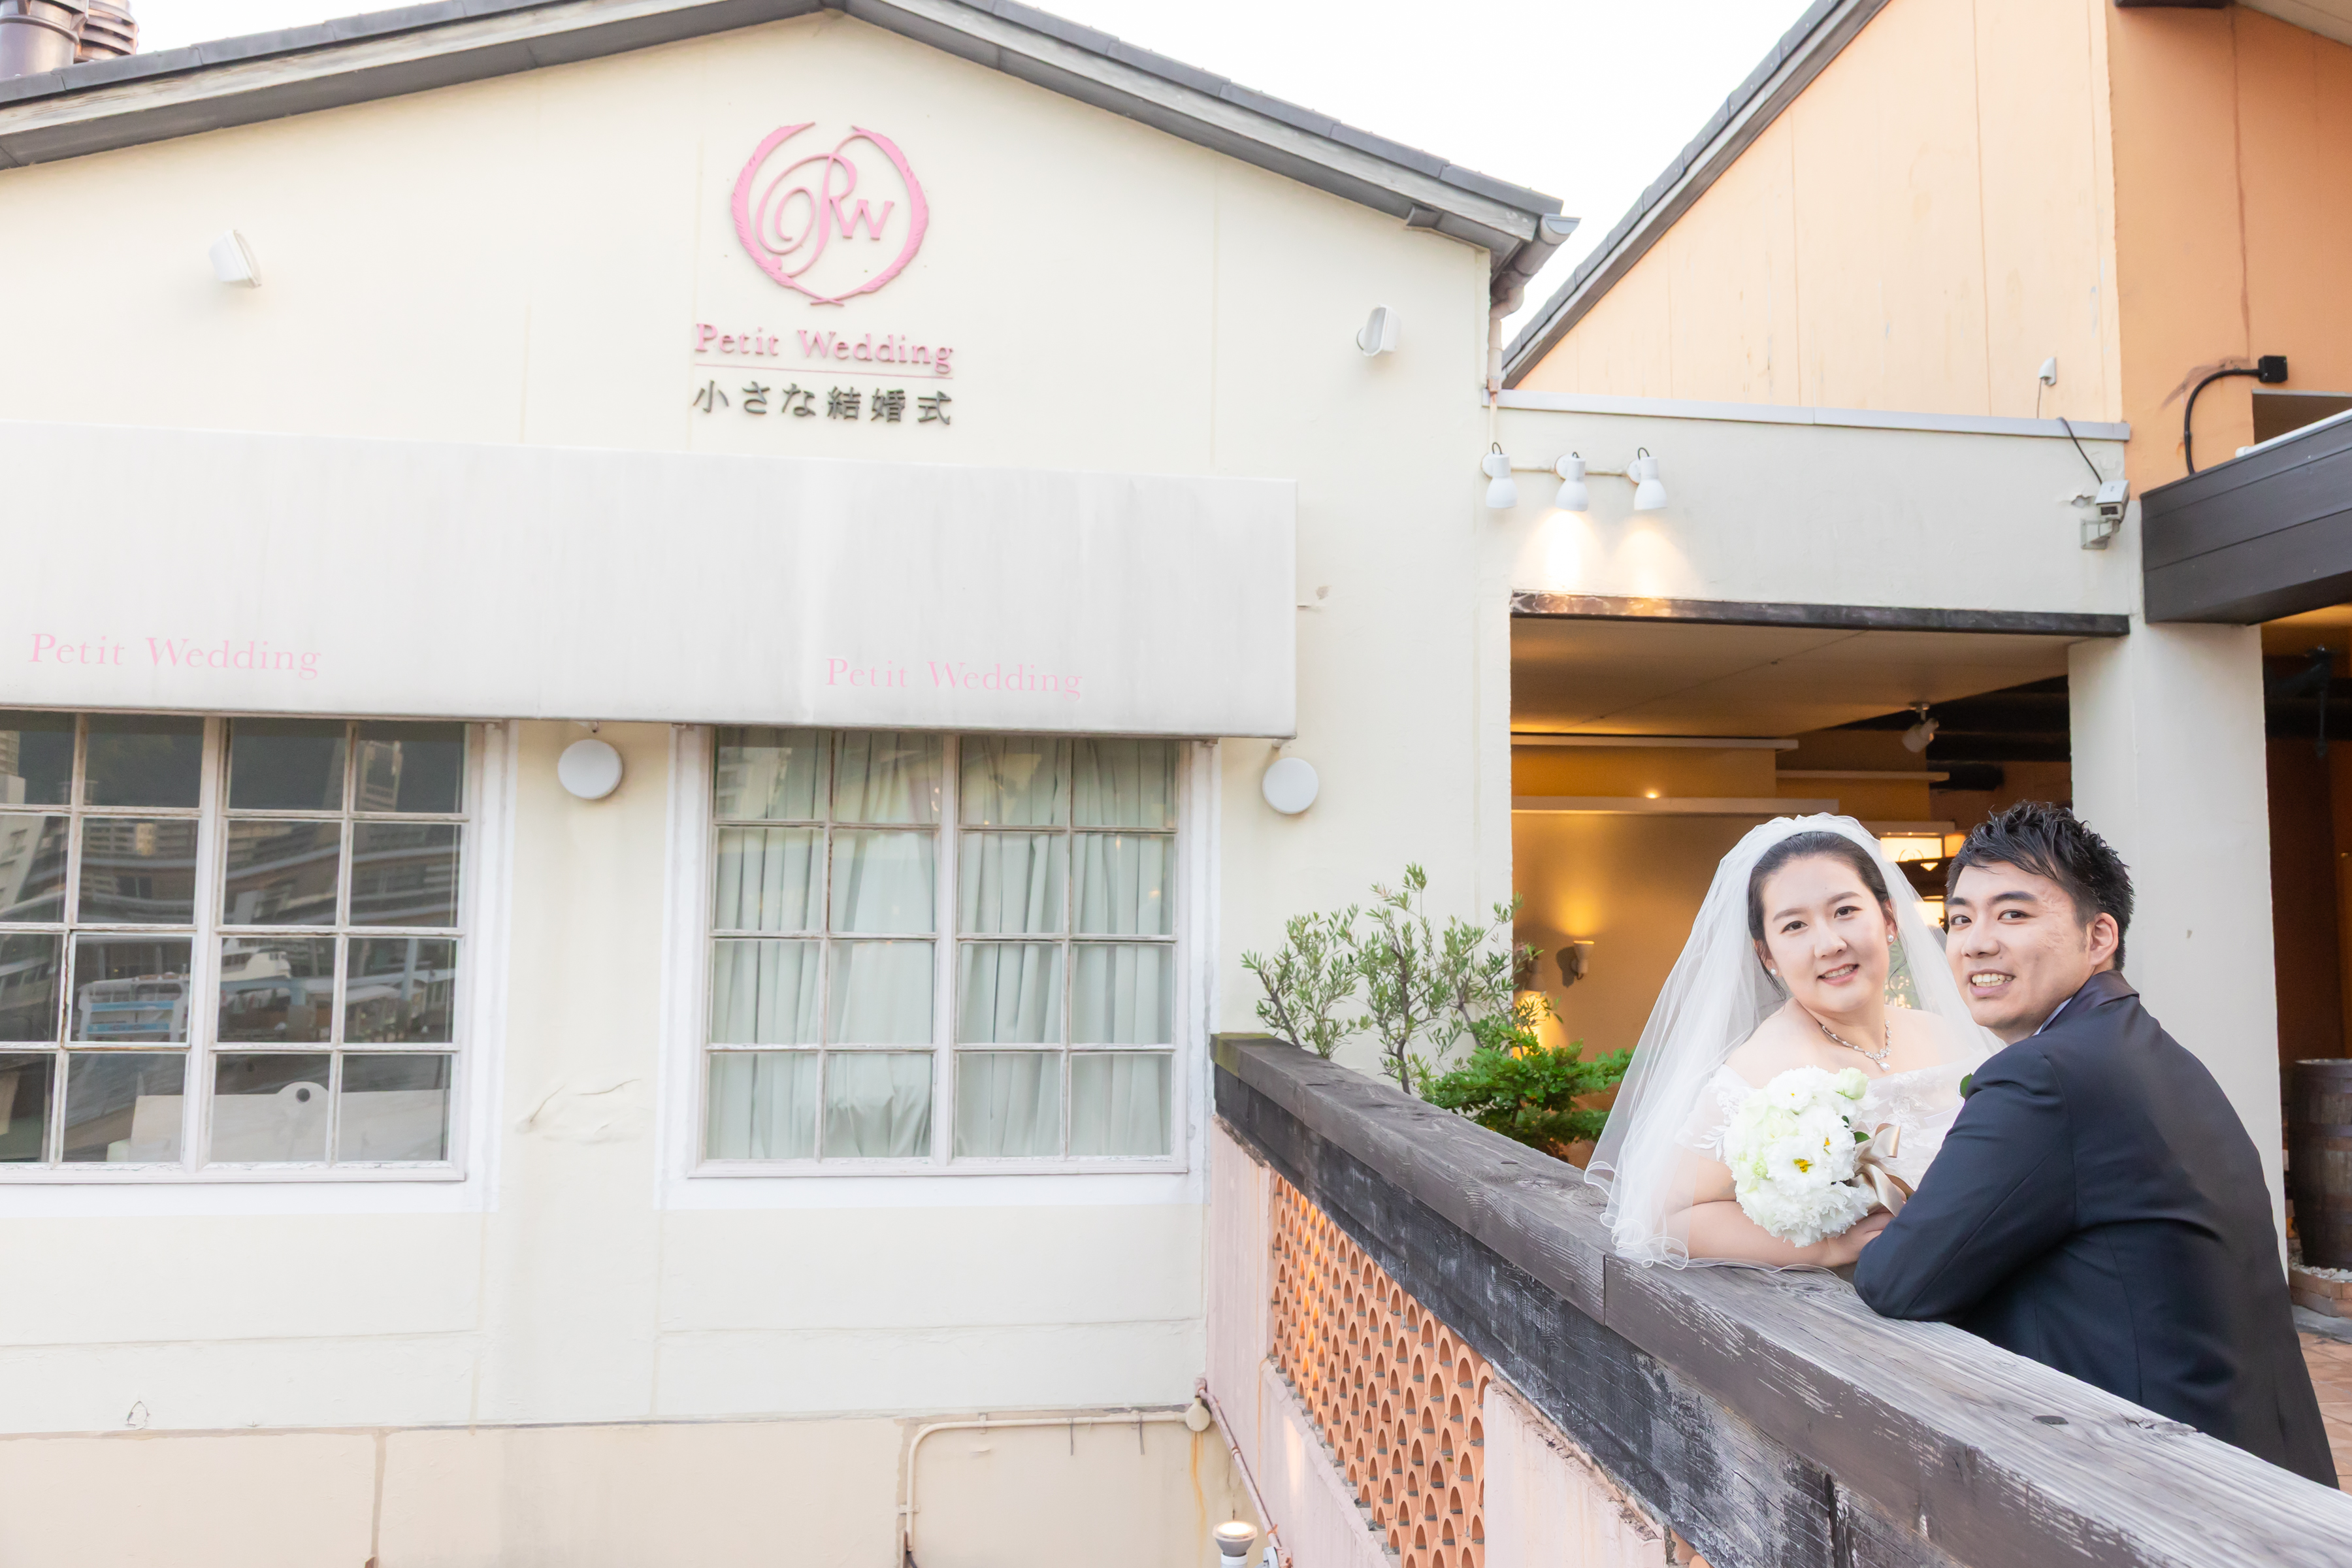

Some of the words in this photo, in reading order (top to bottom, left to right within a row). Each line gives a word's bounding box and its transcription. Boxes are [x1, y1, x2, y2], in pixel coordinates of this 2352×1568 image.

[694, 323, 779, 356] Petit
[797, 329, 954, 374] Wedding
[693, 380, 953, 425] 小さな結婚式
[27, 632, 125, 666] Petit
[145, 636, 322, 681] Wedding
[825, 657, 909, 688] Petit
[926, 661, 1083, 702] Wedding
